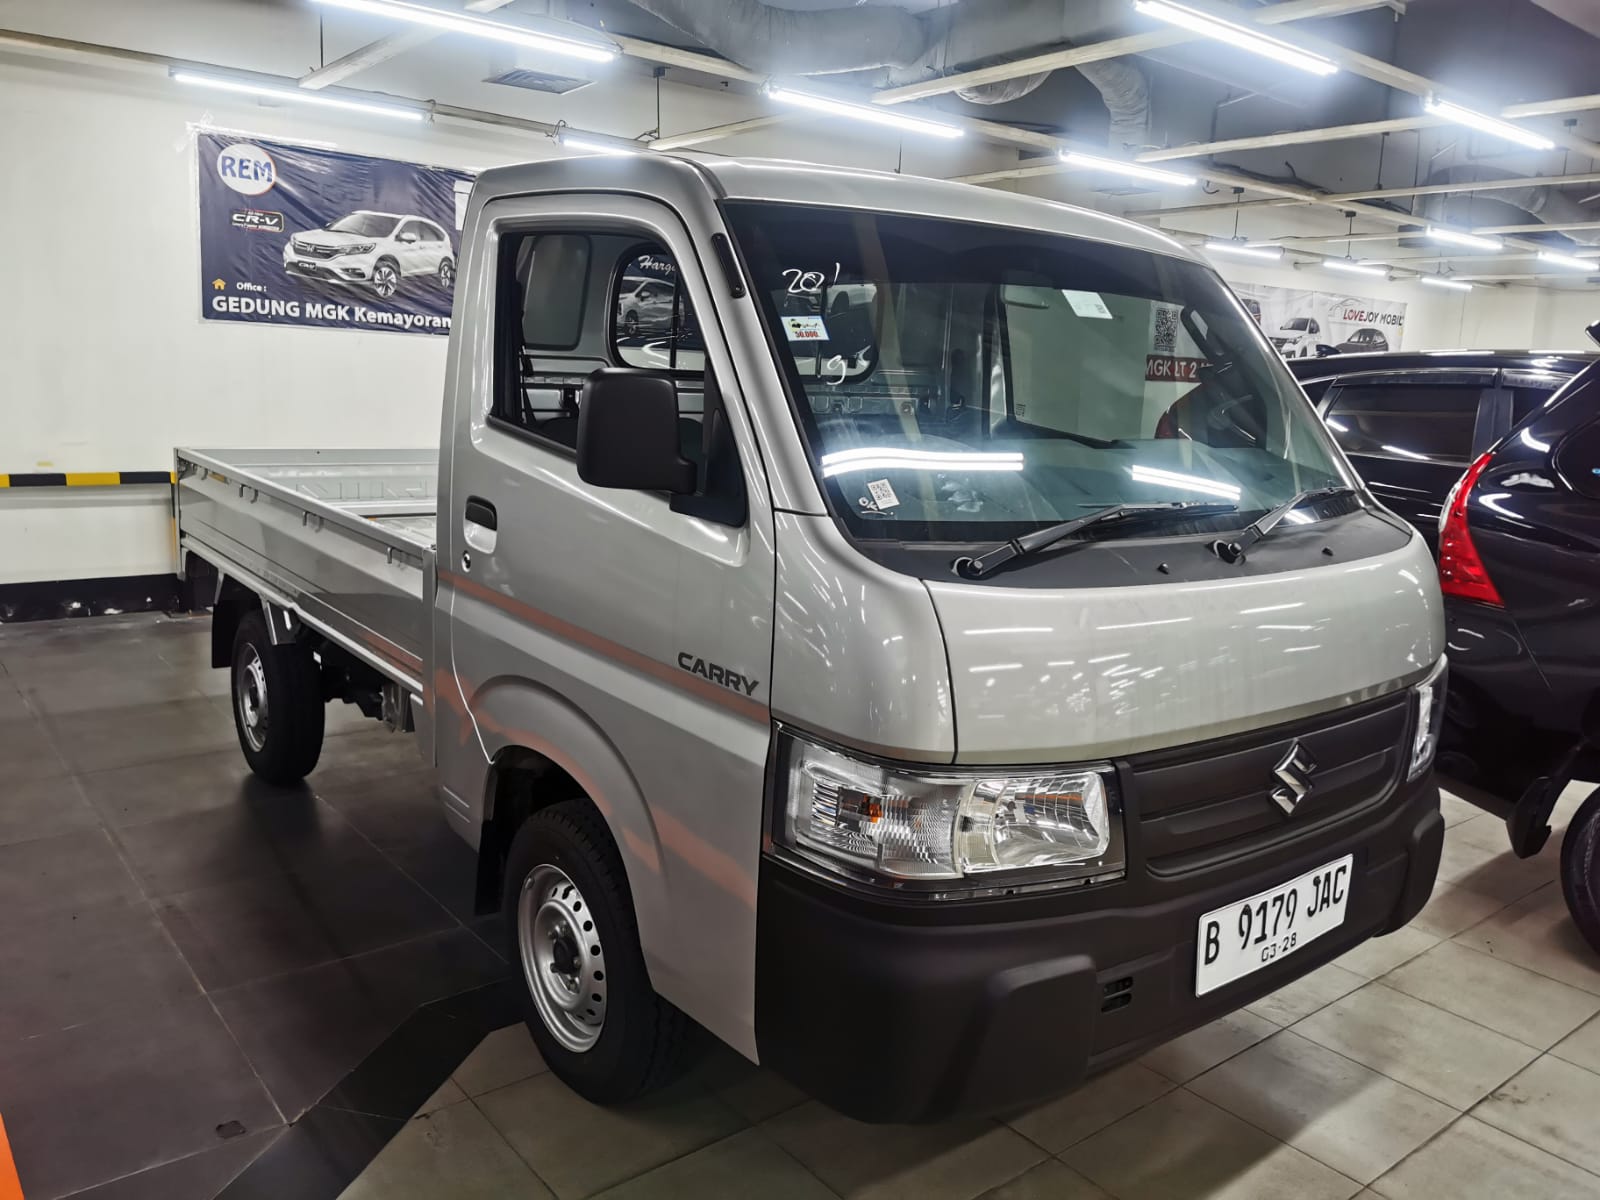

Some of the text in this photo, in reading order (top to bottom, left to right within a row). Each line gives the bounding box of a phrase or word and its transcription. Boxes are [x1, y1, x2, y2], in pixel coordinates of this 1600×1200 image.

[221, 155, 273, 183] REM
[232, 213, 279, 226] CR-V
[236, 282, 263, 291] Office
[211, 295, 451, 329] GEDUNG MGK Kemayoran
[1343, 308, 1379, 323] LOVEJOY
[1189, 361, 1198, 378] 2
[677, 651, 760, 697] CARRY
[1204, 865, 1348, 966] B 9179 JAC
